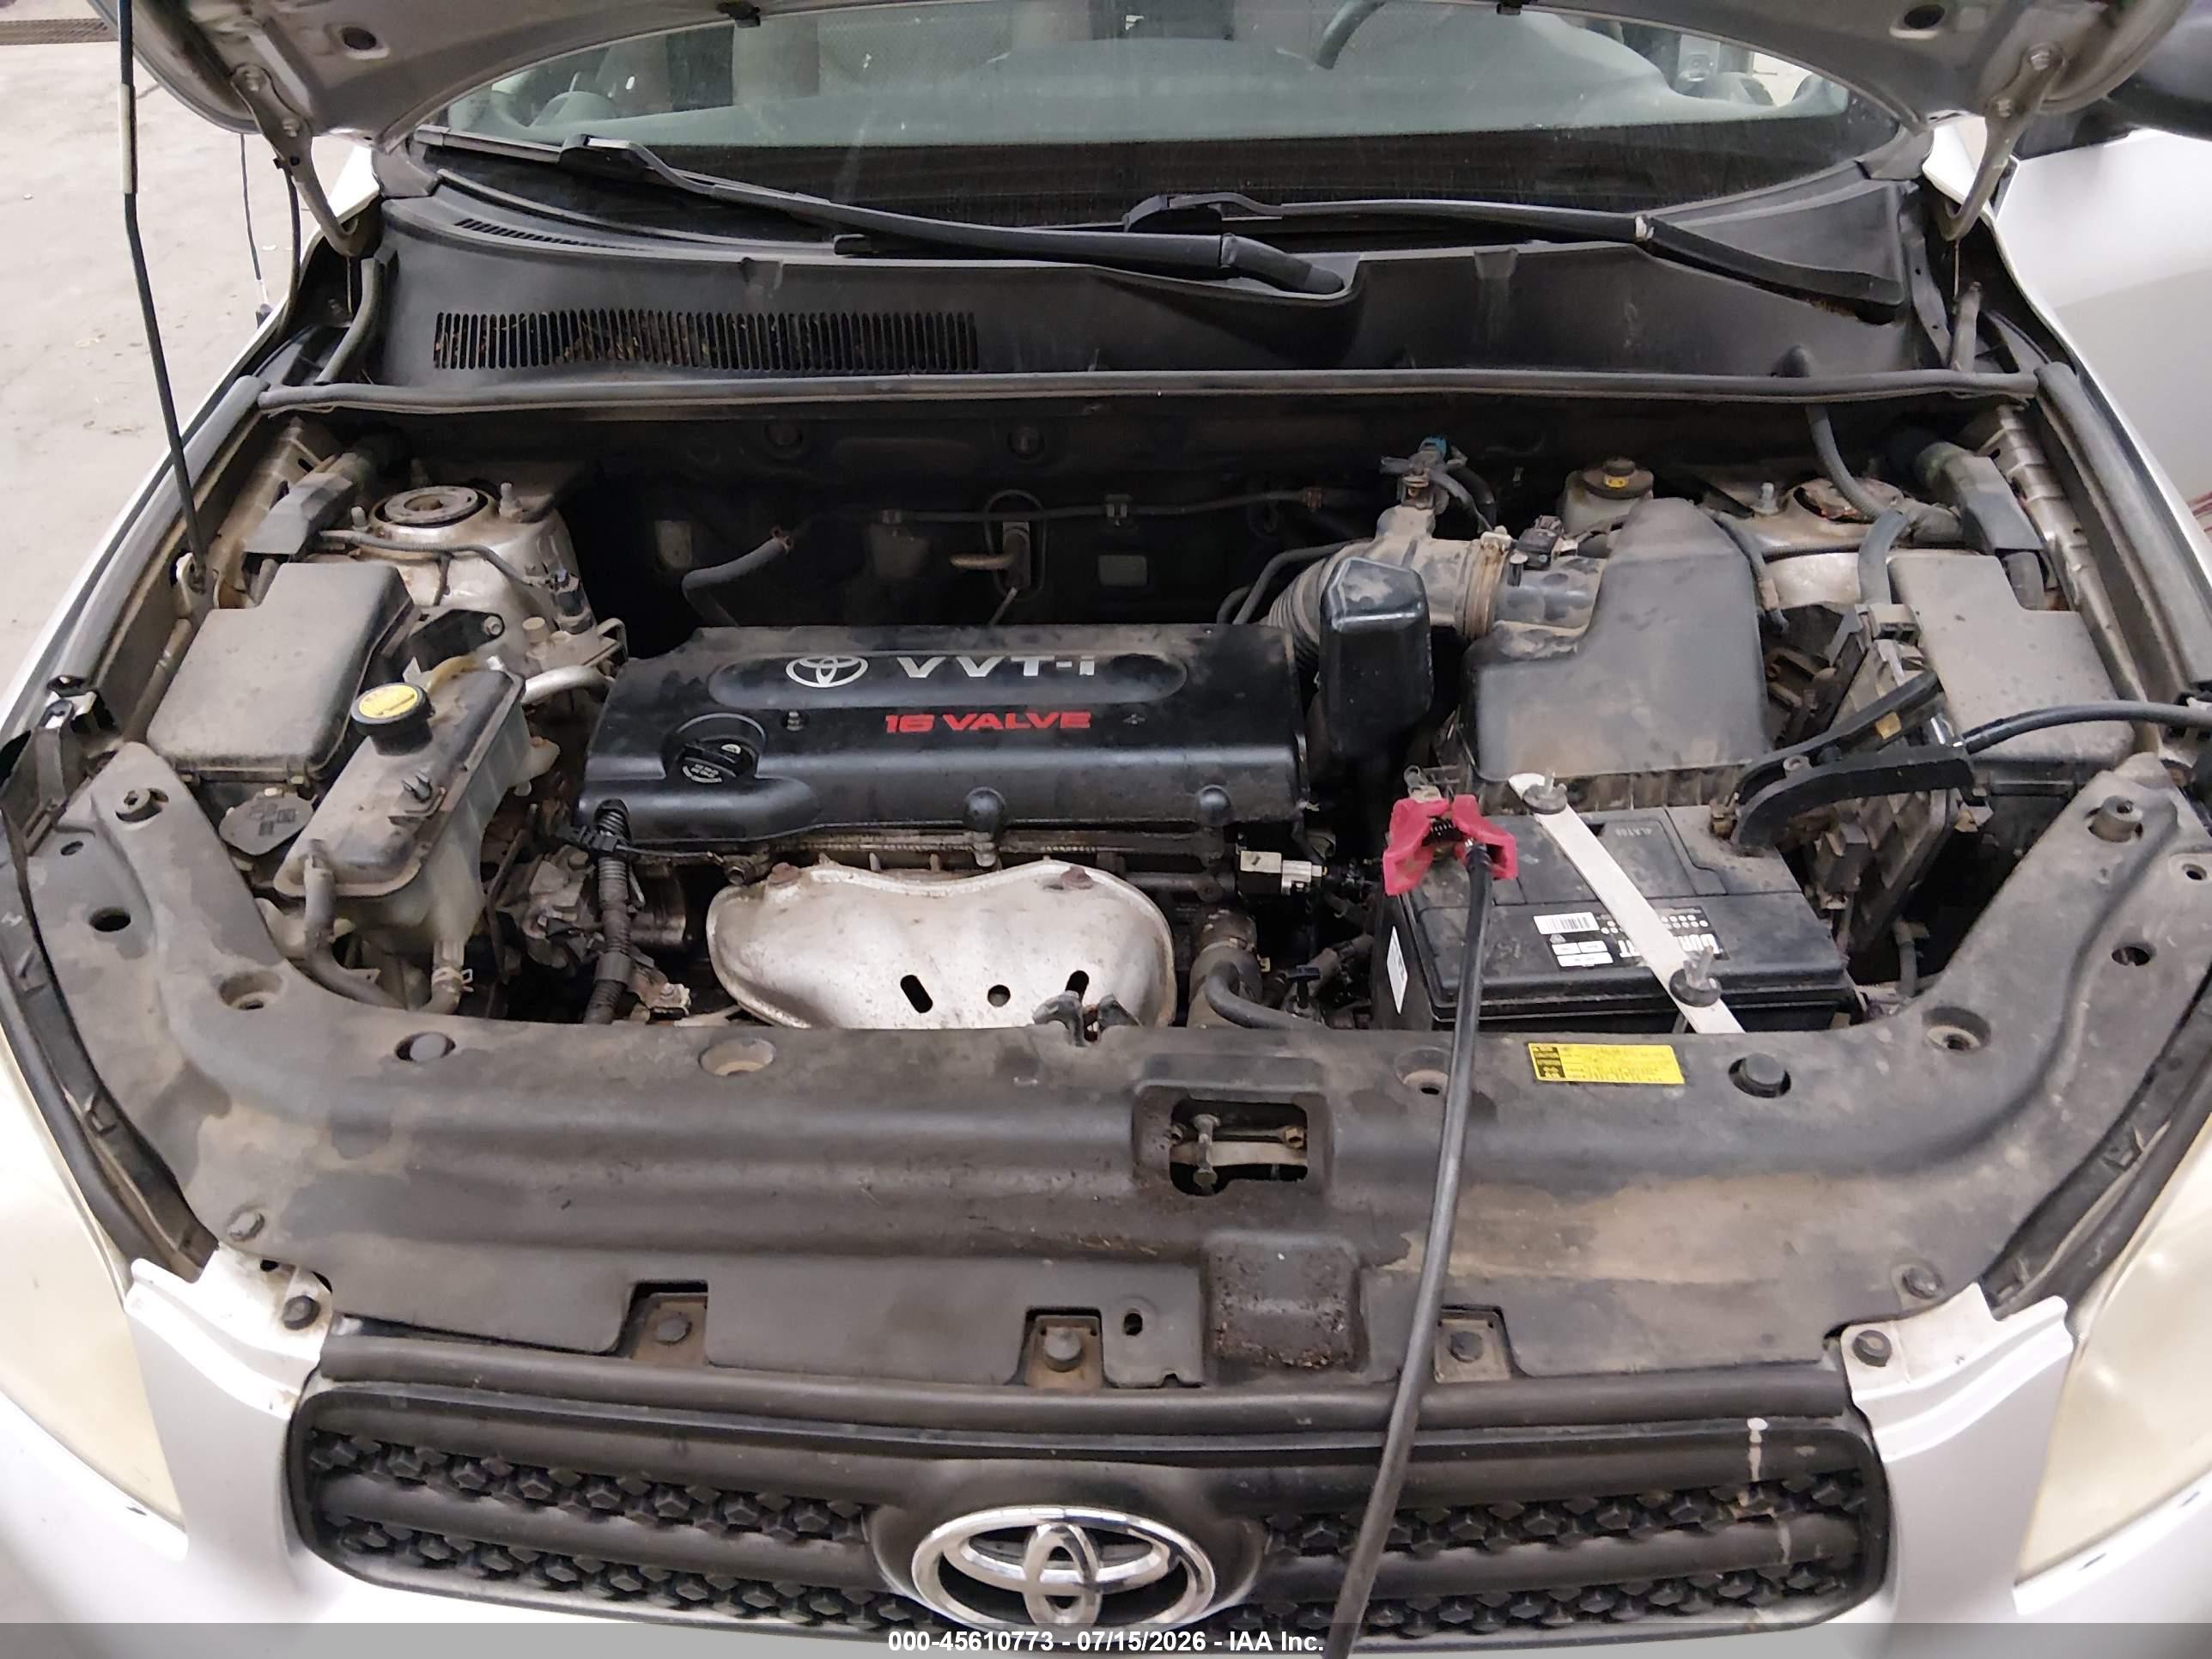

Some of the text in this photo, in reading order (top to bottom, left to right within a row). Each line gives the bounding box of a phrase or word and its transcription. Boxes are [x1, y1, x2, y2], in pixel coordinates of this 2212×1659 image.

[897, 655, 1095, 678] VVT-i
[885, 712, 1092, 733] 16 VALVE
